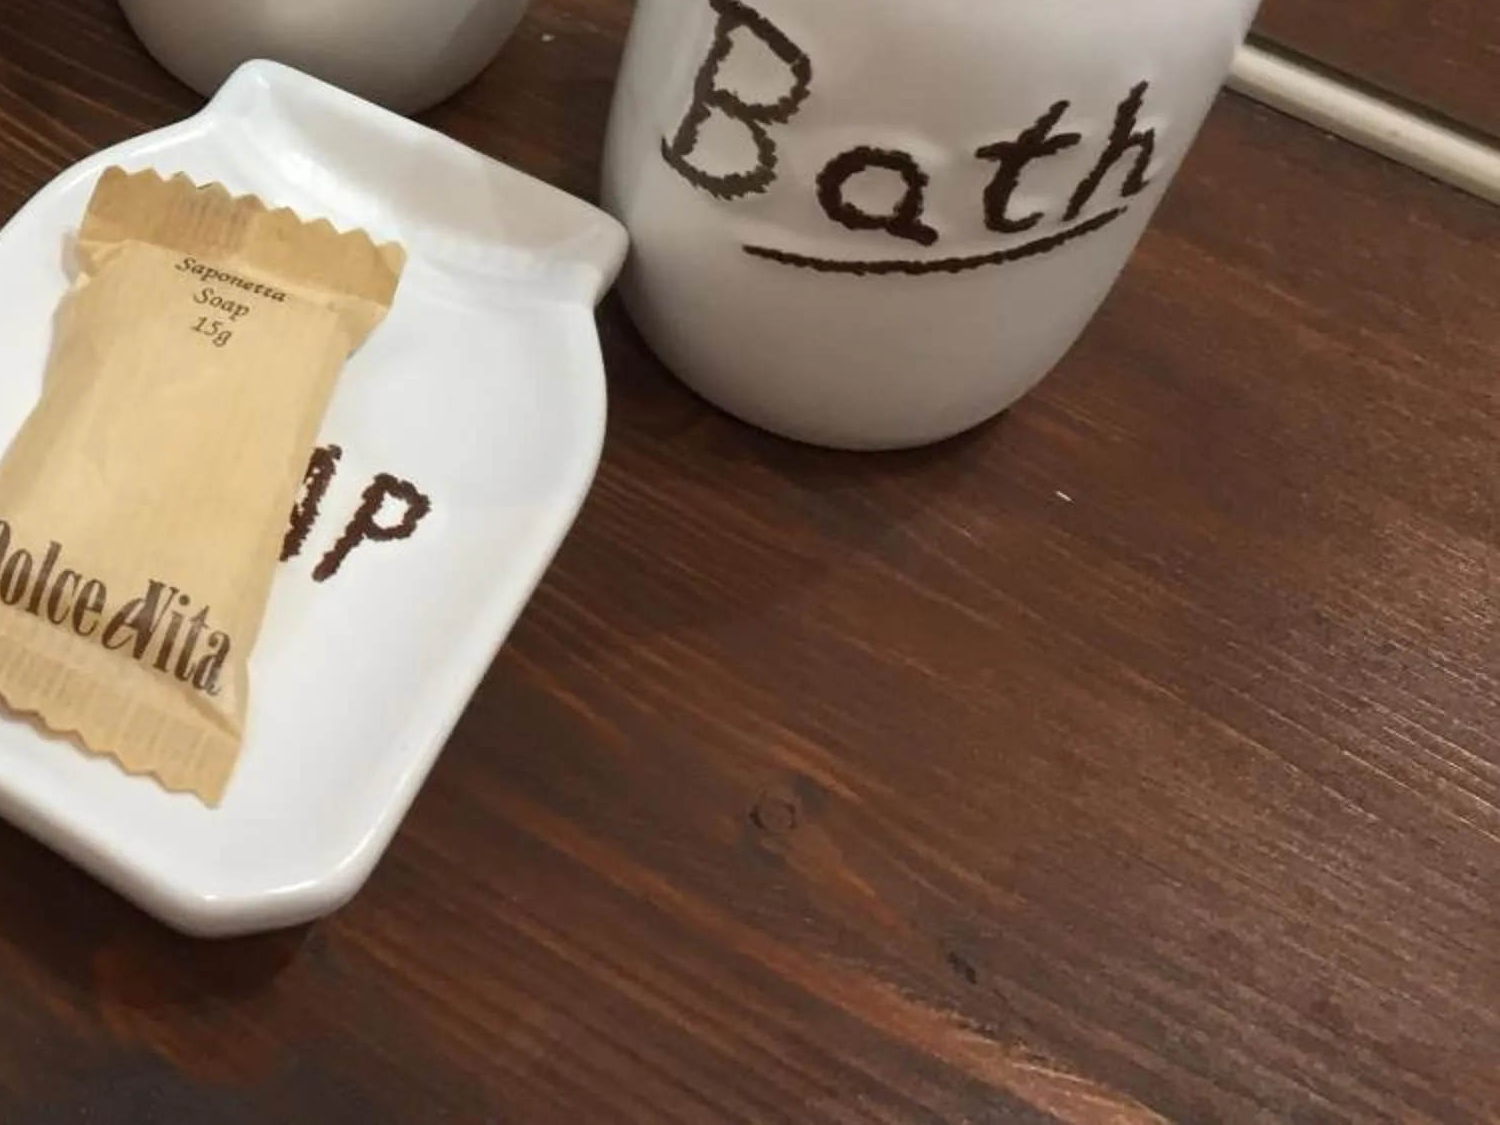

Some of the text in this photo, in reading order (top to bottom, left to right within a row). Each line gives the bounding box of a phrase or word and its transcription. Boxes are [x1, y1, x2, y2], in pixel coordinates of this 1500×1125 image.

[175, 257, 288, 303] Saponetta
[193, 286, 250, 319] Soap
[189, 315, 232, 347] 15g
